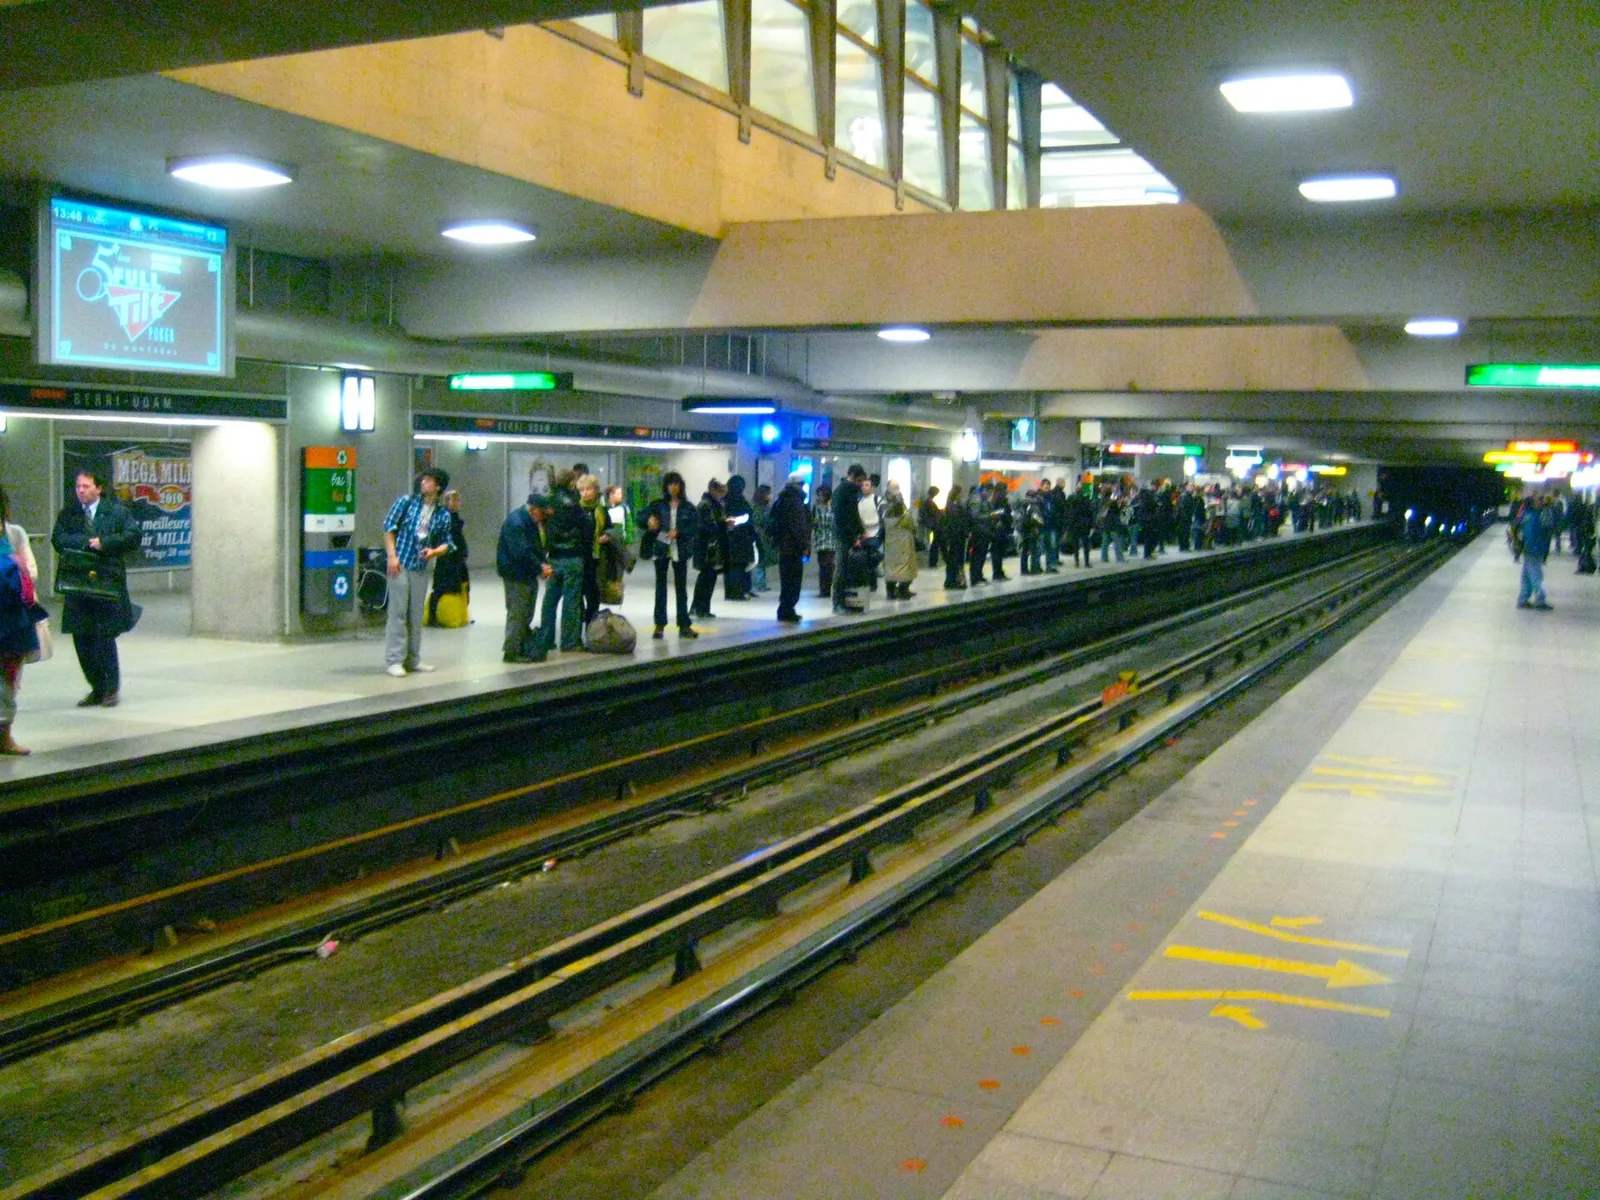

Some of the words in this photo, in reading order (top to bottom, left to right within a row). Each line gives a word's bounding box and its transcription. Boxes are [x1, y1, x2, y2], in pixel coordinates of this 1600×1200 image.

[113, 267, 161, 289] FULL
[108, 290, 166, 327] Tilt
[148, 325, 175, 343] POKER
[73, 391, 172, 410] BERRI-UQAM
[117, 458, 158, 483] MEGA
[159, 492, 184, 505] 2010
